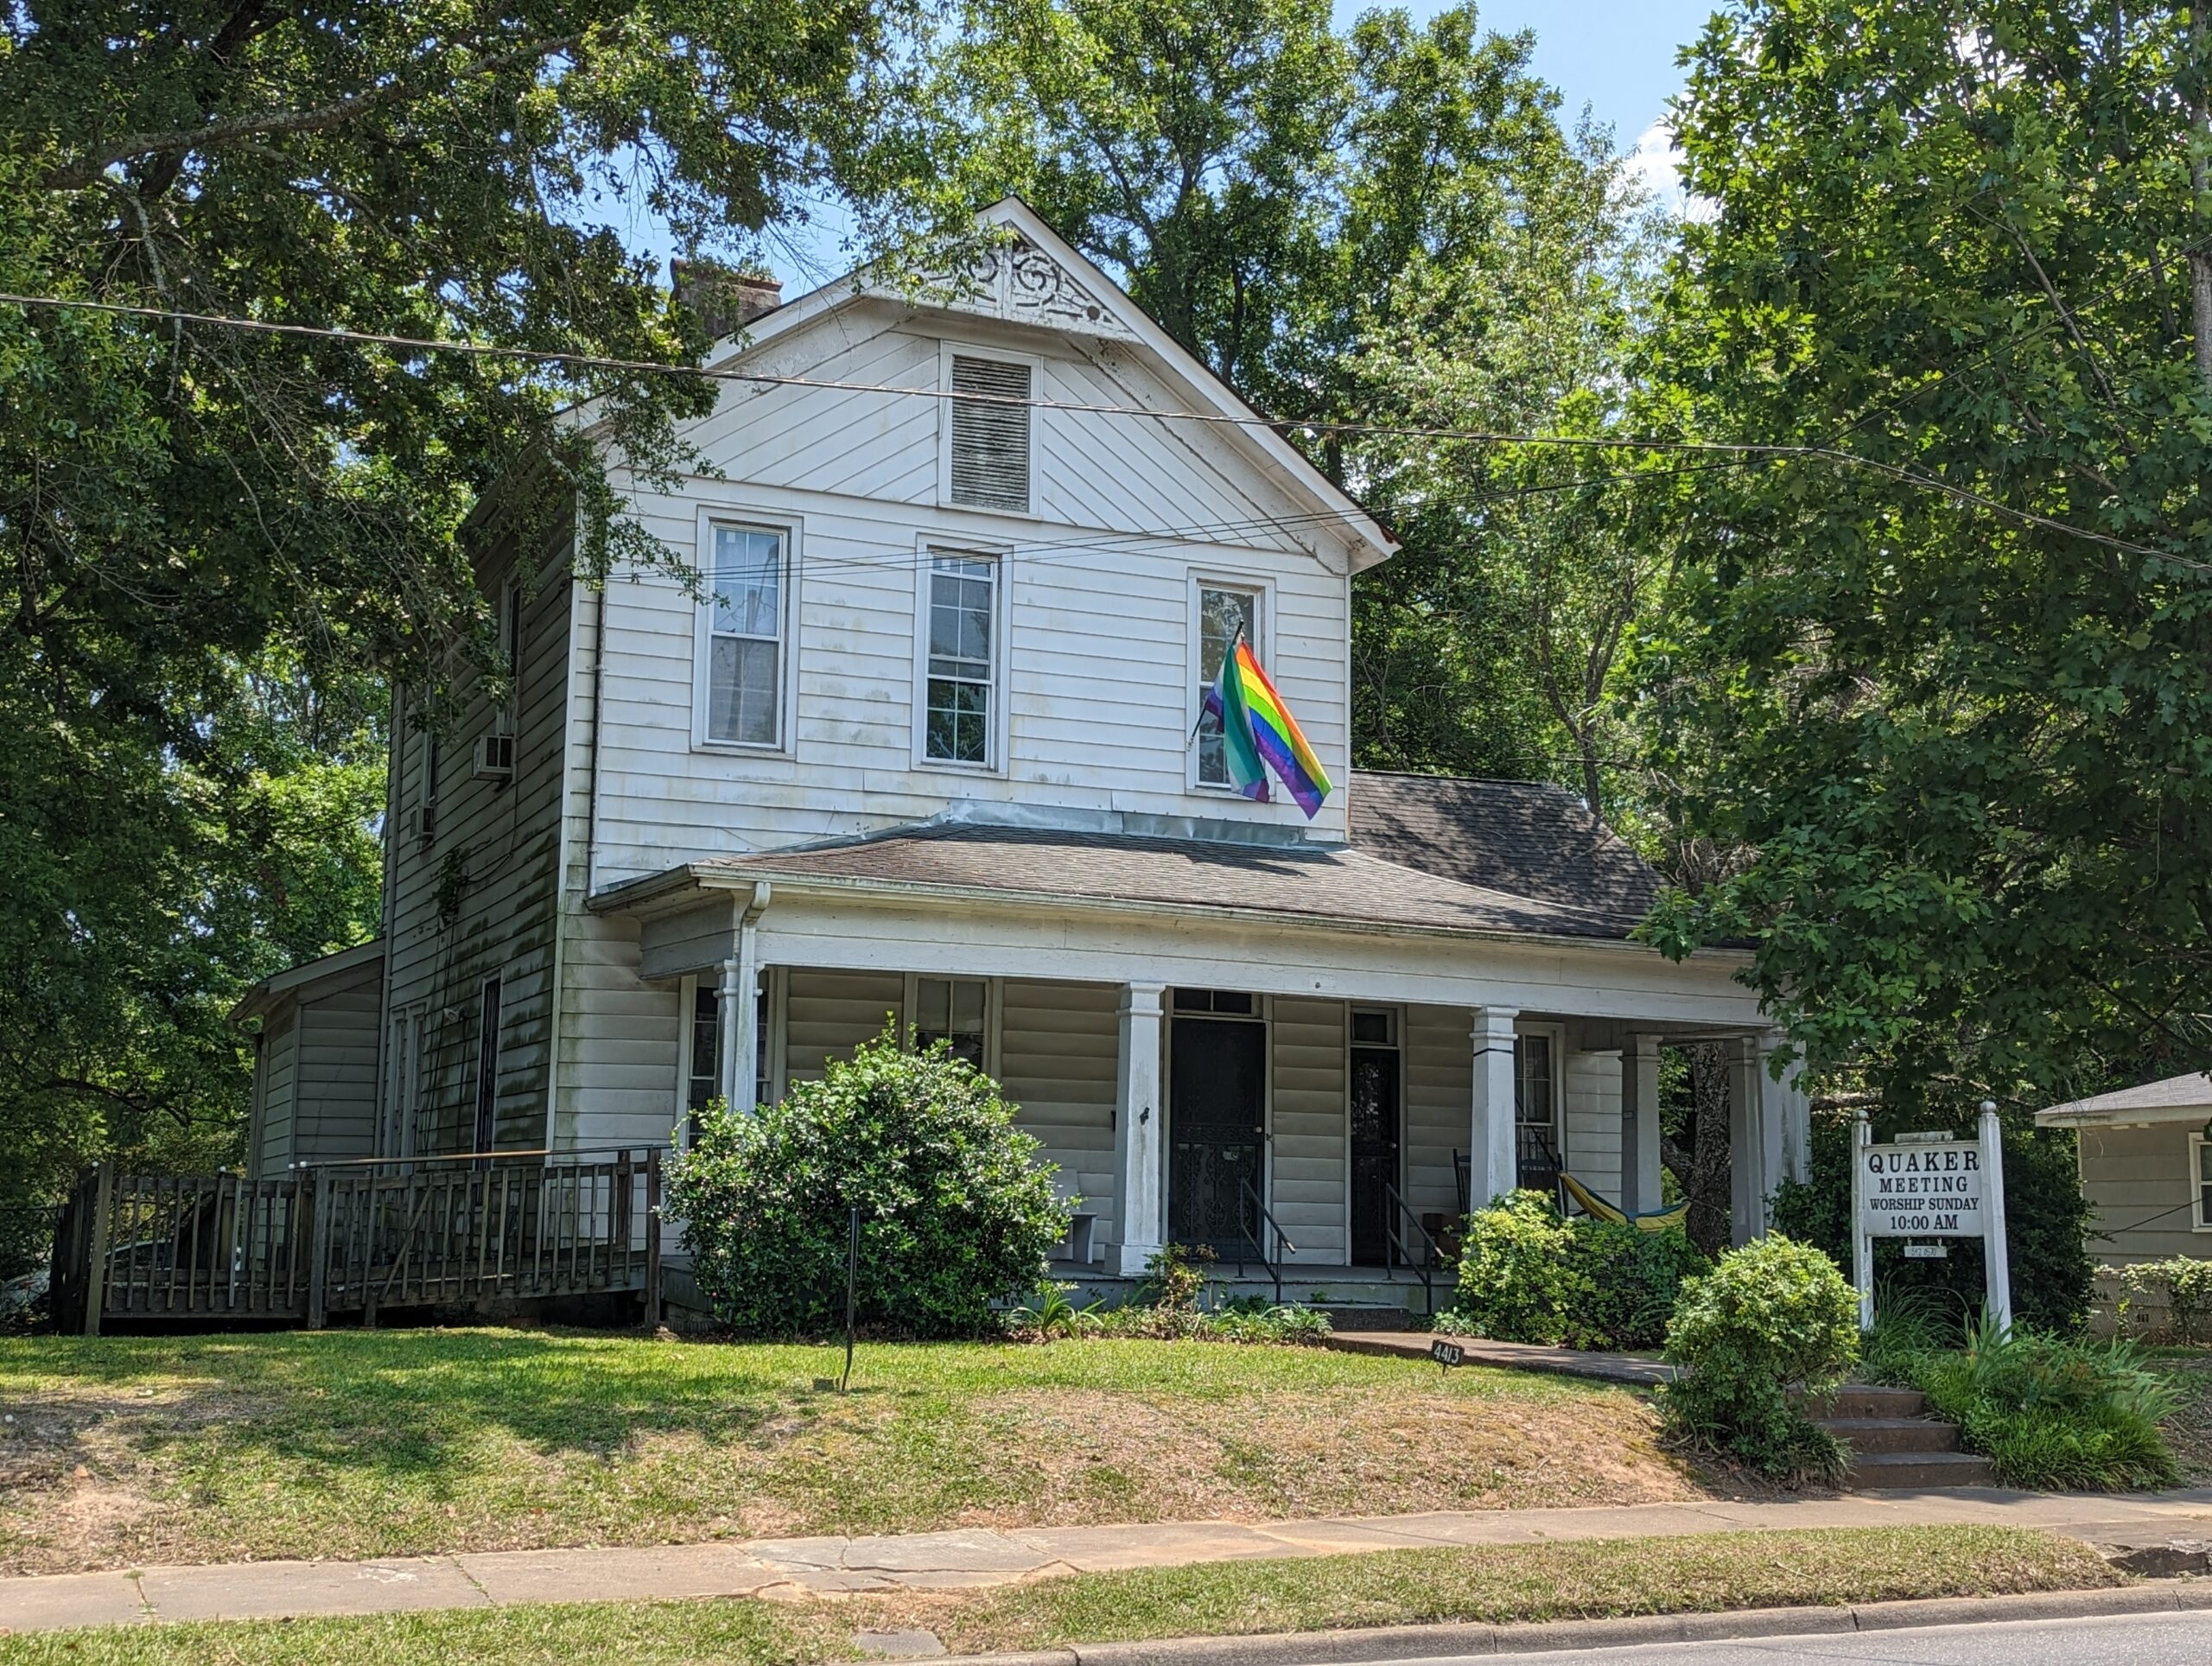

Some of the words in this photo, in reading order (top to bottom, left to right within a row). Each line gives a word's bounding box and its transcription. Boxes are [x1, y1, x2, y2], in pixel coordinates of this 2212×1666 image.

[1868, 1150, 1980, 1174] QUAKER
[1878, 1176, 1968, 1193] MEETING
[1869, 1198, 1925, 1211] WORSHIP
[1928, 1198, 1980, 1211] SUNDAY
[1890, 1215, 1929, 1230] 10:00
[1933, 1214, 1959, 1230] AM
[1433, 1344, 1460, 1364] 4413
